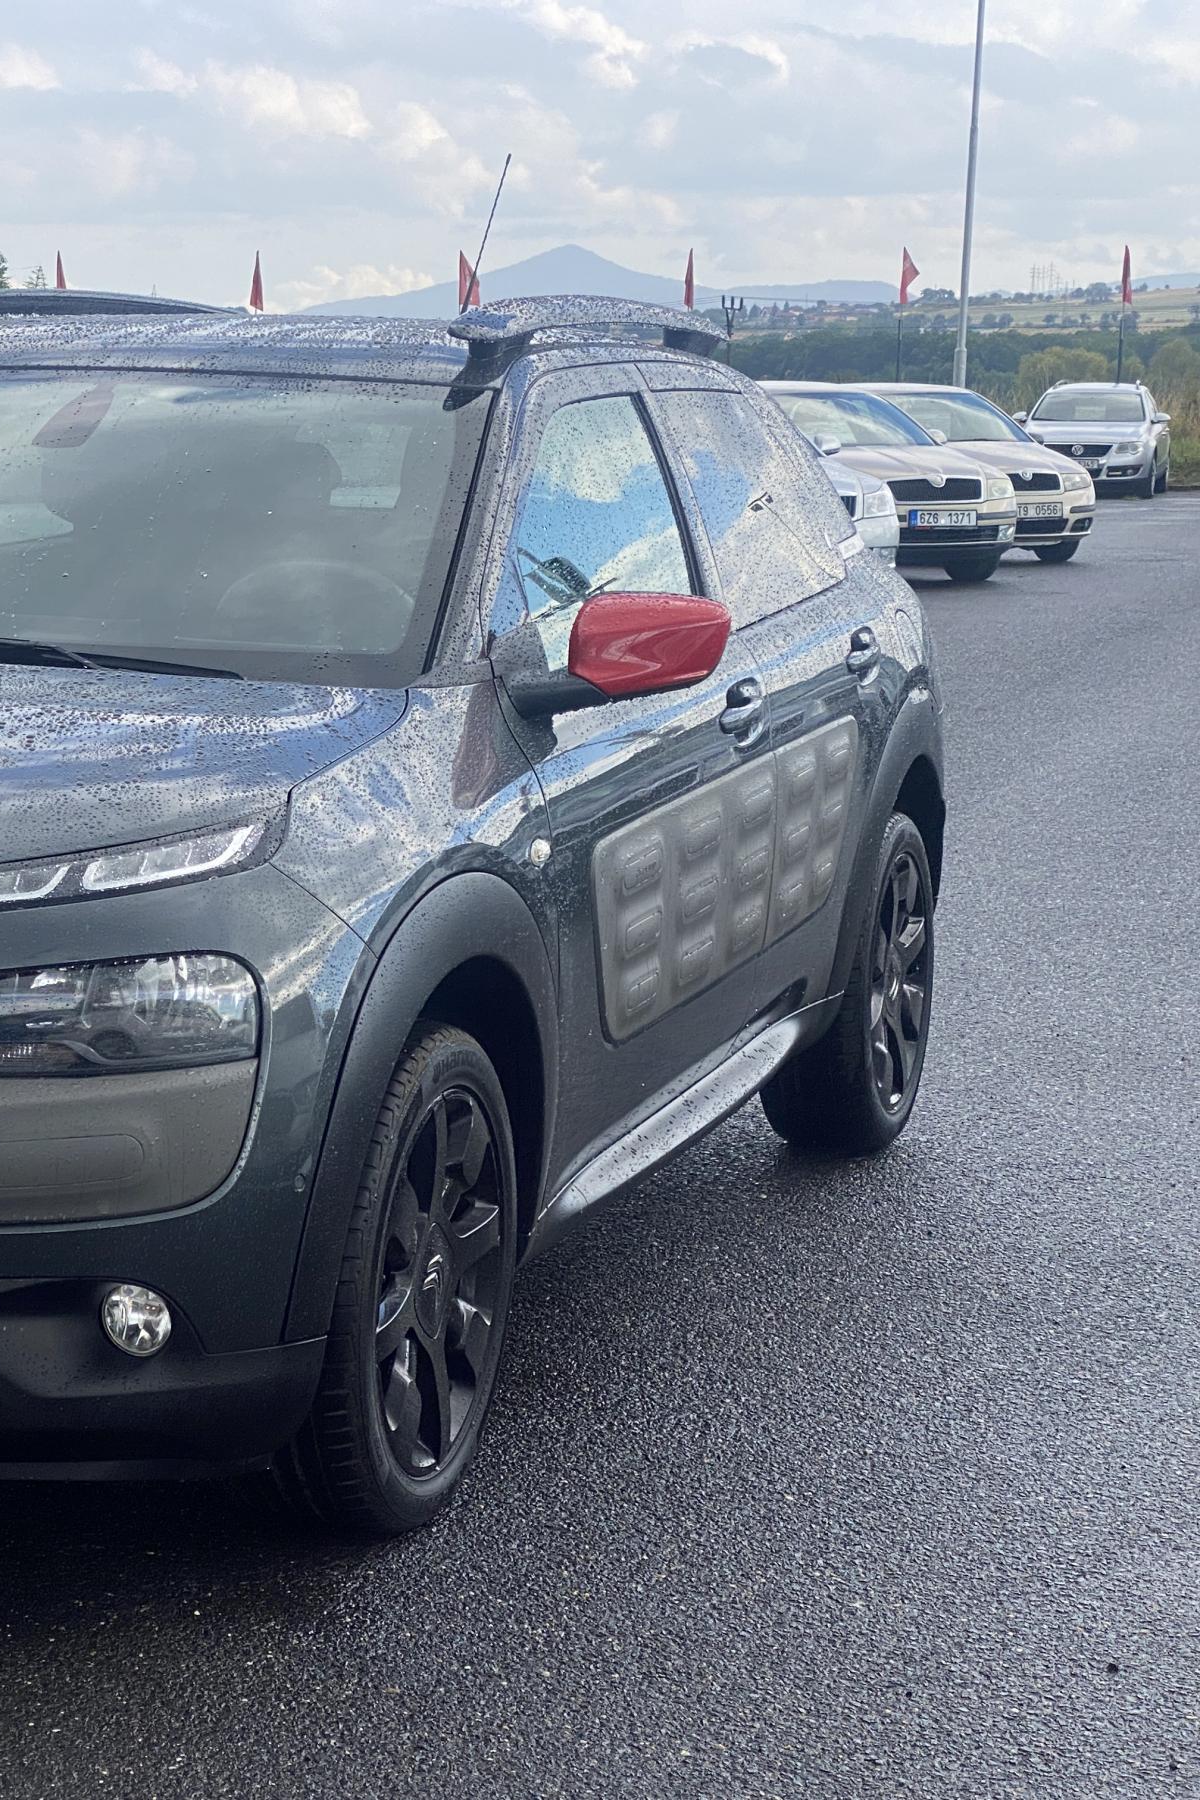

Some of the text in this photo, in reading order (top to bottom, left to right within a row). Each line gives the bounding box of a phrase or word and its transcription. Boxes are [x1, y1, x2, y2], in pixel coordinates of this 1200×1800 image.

[1035, 504, 1058, 516] 0556
[919, 512, 972, 525] 6Z6 1371
